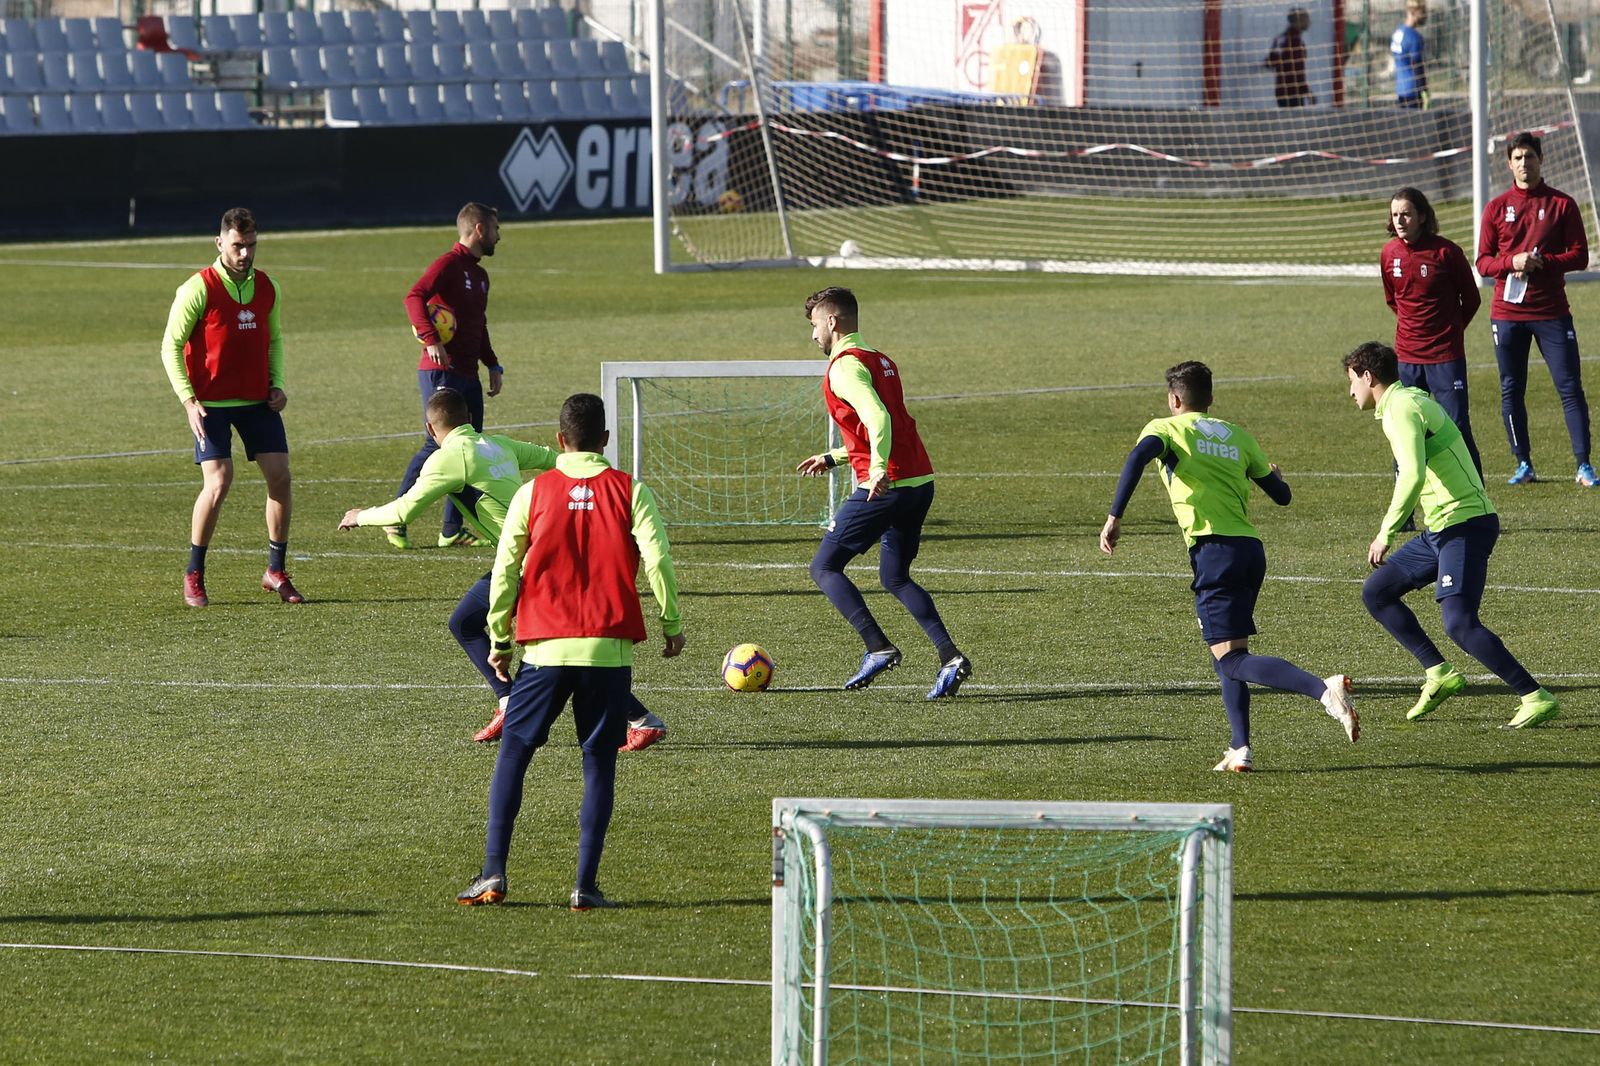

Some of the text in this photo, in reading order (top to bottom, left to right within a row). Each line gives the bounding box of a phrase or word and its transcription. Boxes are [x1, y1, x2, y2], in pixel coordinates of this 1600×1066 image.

[575, 121, 729, 209] errea
[1196, 439, 1239, 461] errea
[568, 502, 594, 510] errea
